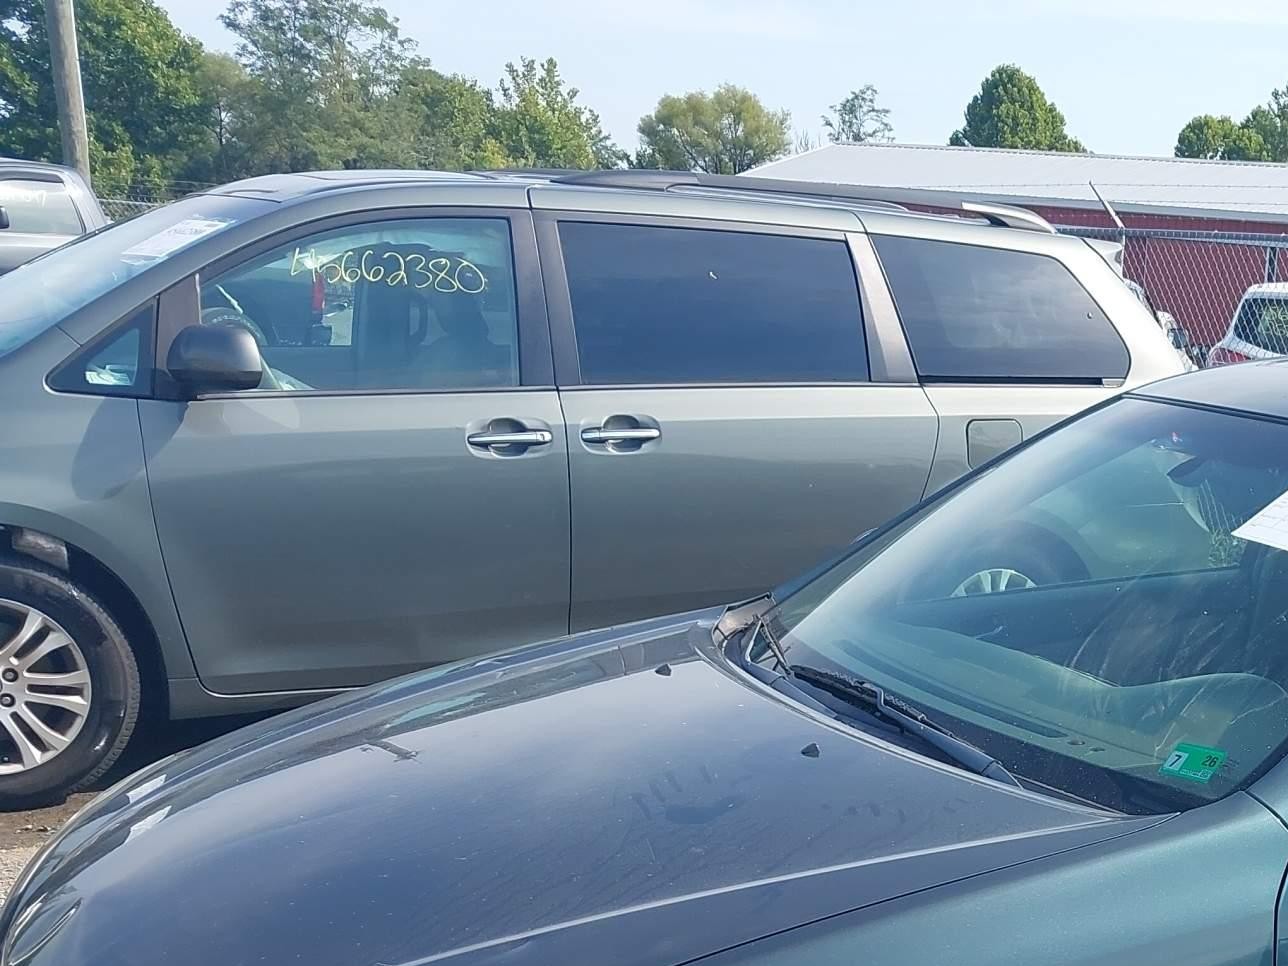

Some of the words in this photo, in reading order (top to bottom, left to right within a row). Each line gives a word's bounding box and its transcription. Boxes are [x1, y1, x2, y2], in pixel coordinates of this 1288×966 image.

[290, 247, 485, 294] 45662380
[1168, 753, 1182, 768] 7
[1201, 755, 1219, 768] 26
